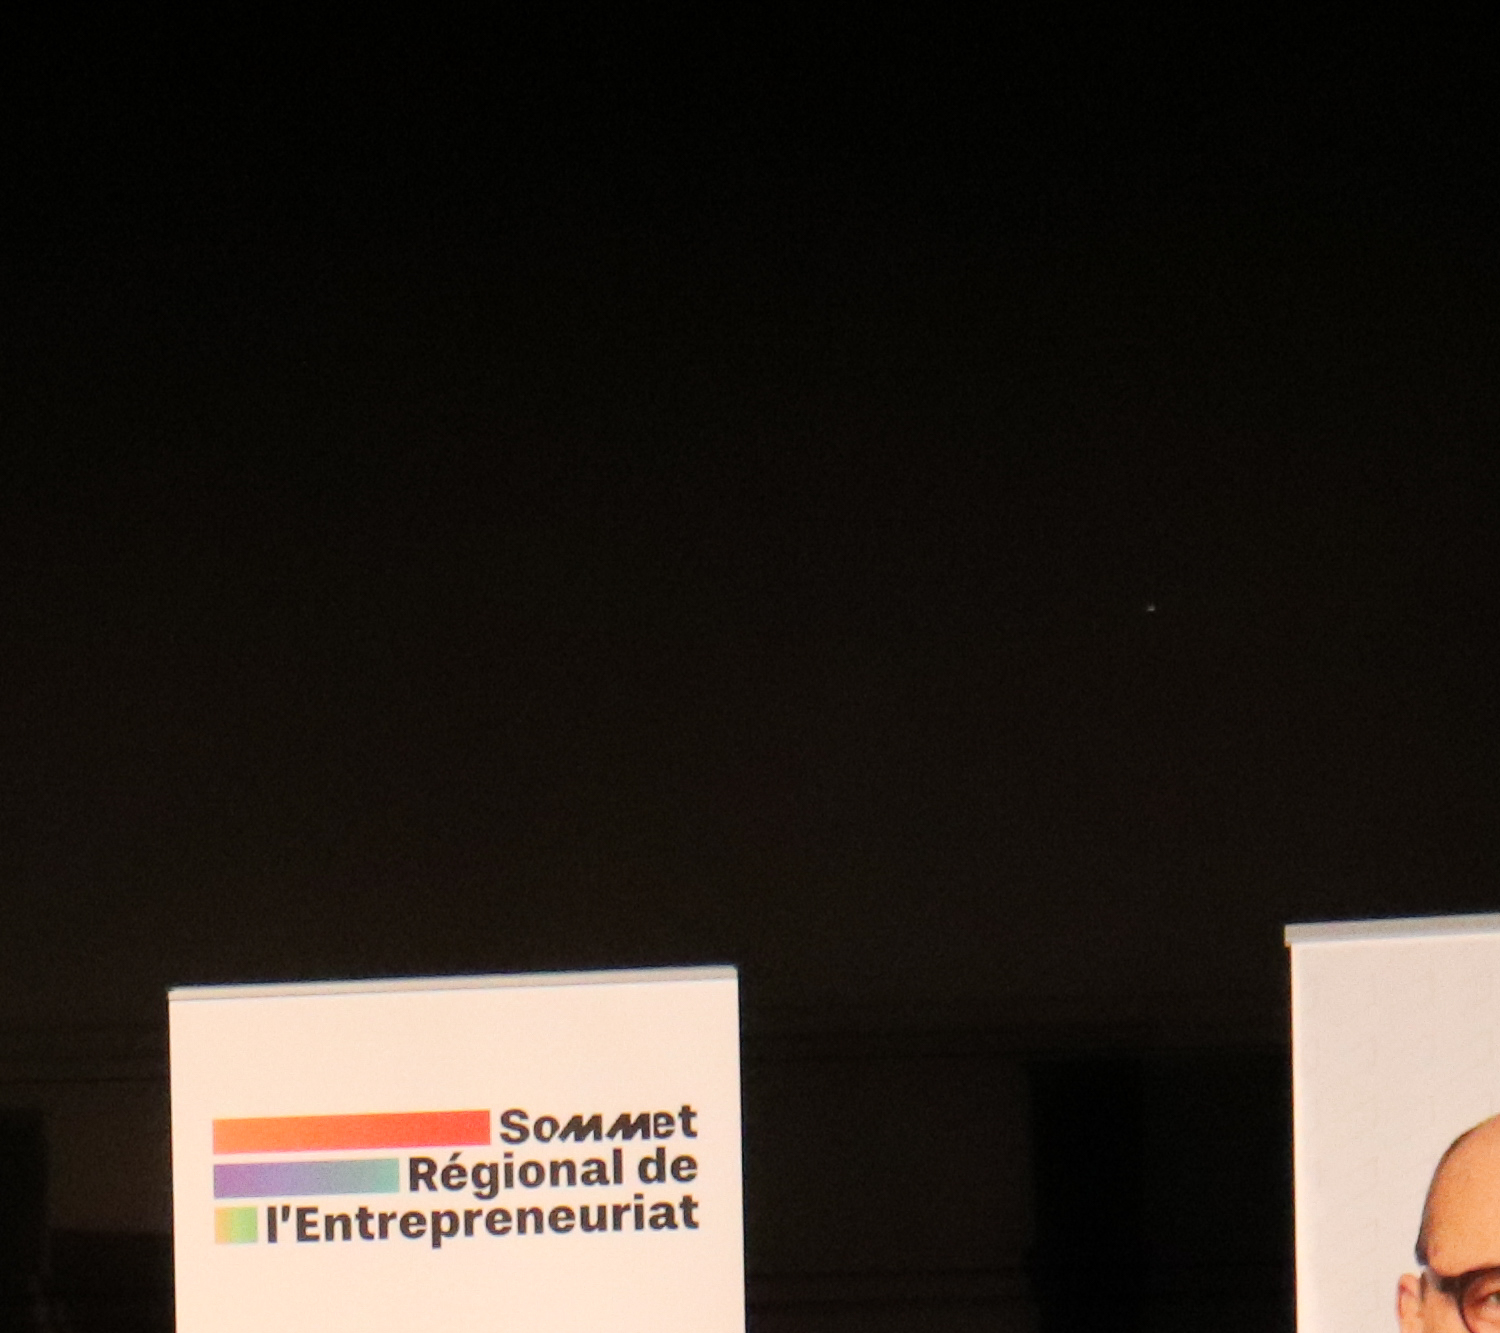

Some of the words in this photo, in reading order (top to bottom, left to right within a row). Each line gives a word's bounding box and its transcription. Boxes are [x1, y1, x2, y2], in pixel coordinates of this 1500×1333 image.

[500, 1105, 697, 1144] Sommet
[409, 1148, 623, 1200] Régional
[638, 1147, 697, 1184] de
[267, 1194, 699, 1249] l'Entrepreneuriat
